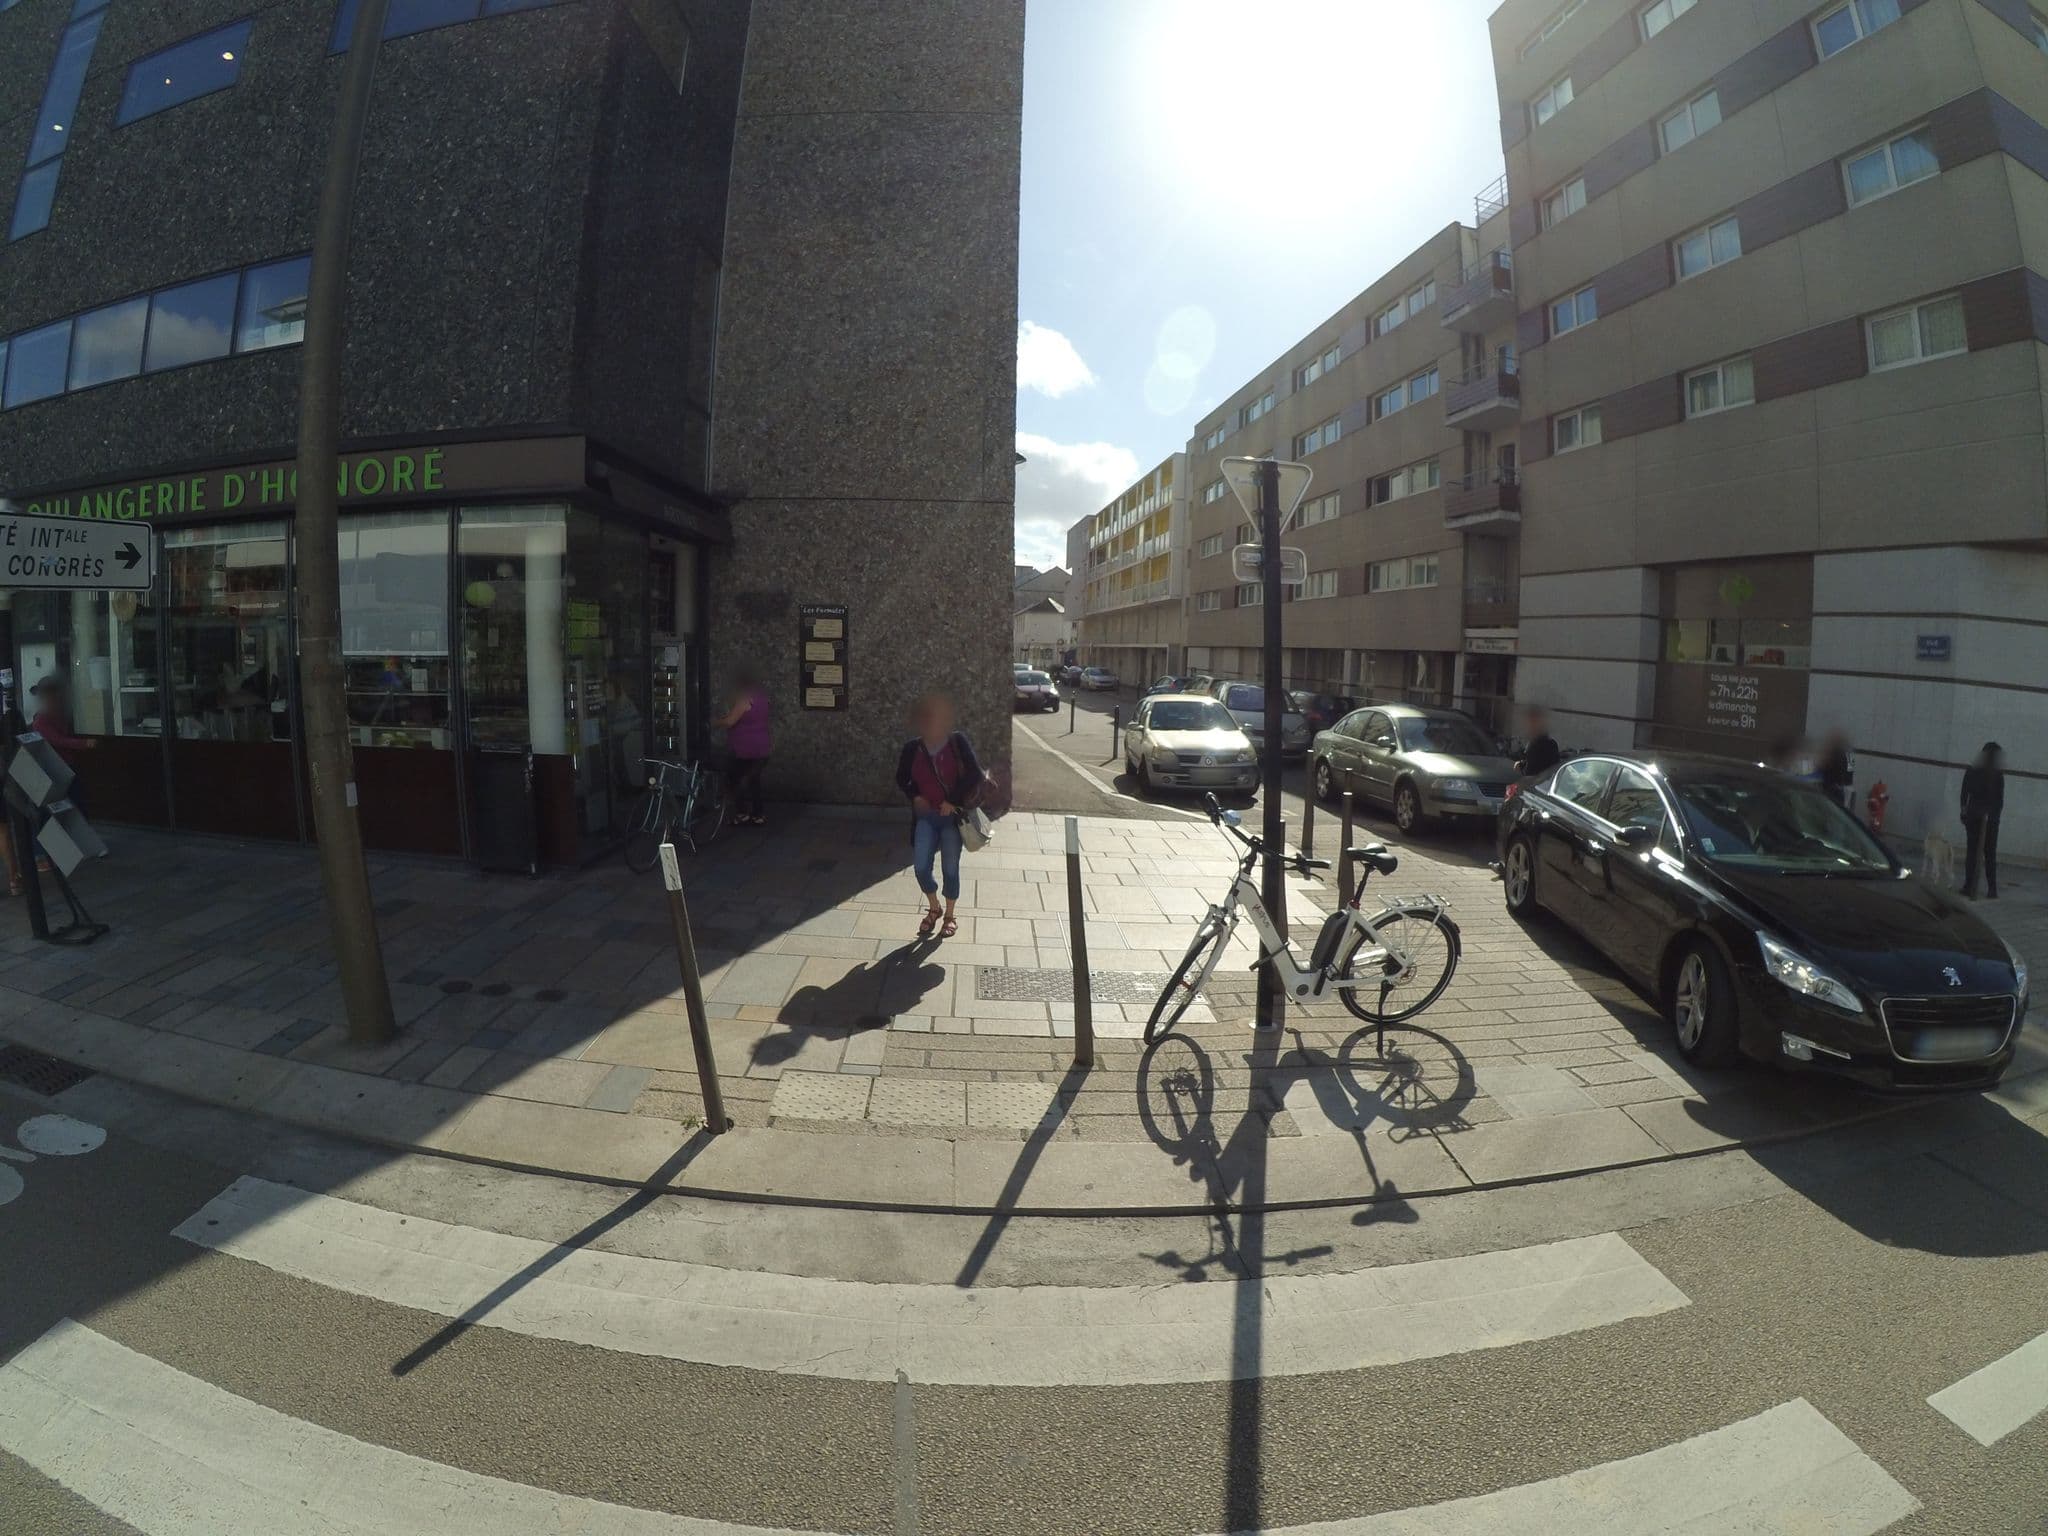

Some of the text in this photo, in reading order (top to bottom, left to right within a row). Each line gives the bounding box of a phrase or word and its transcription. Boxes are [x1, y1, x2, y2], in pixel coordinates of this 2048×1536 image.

[28, 449, 444, 520] ANGERIE D'HORÉ
[8, 553, 104, 577] CONGRÈS
[1717, 684, 1731, 697] 7h
[1736, 685, 1758, 700] 22h
[1740, 714, 1756, 729] 9h
